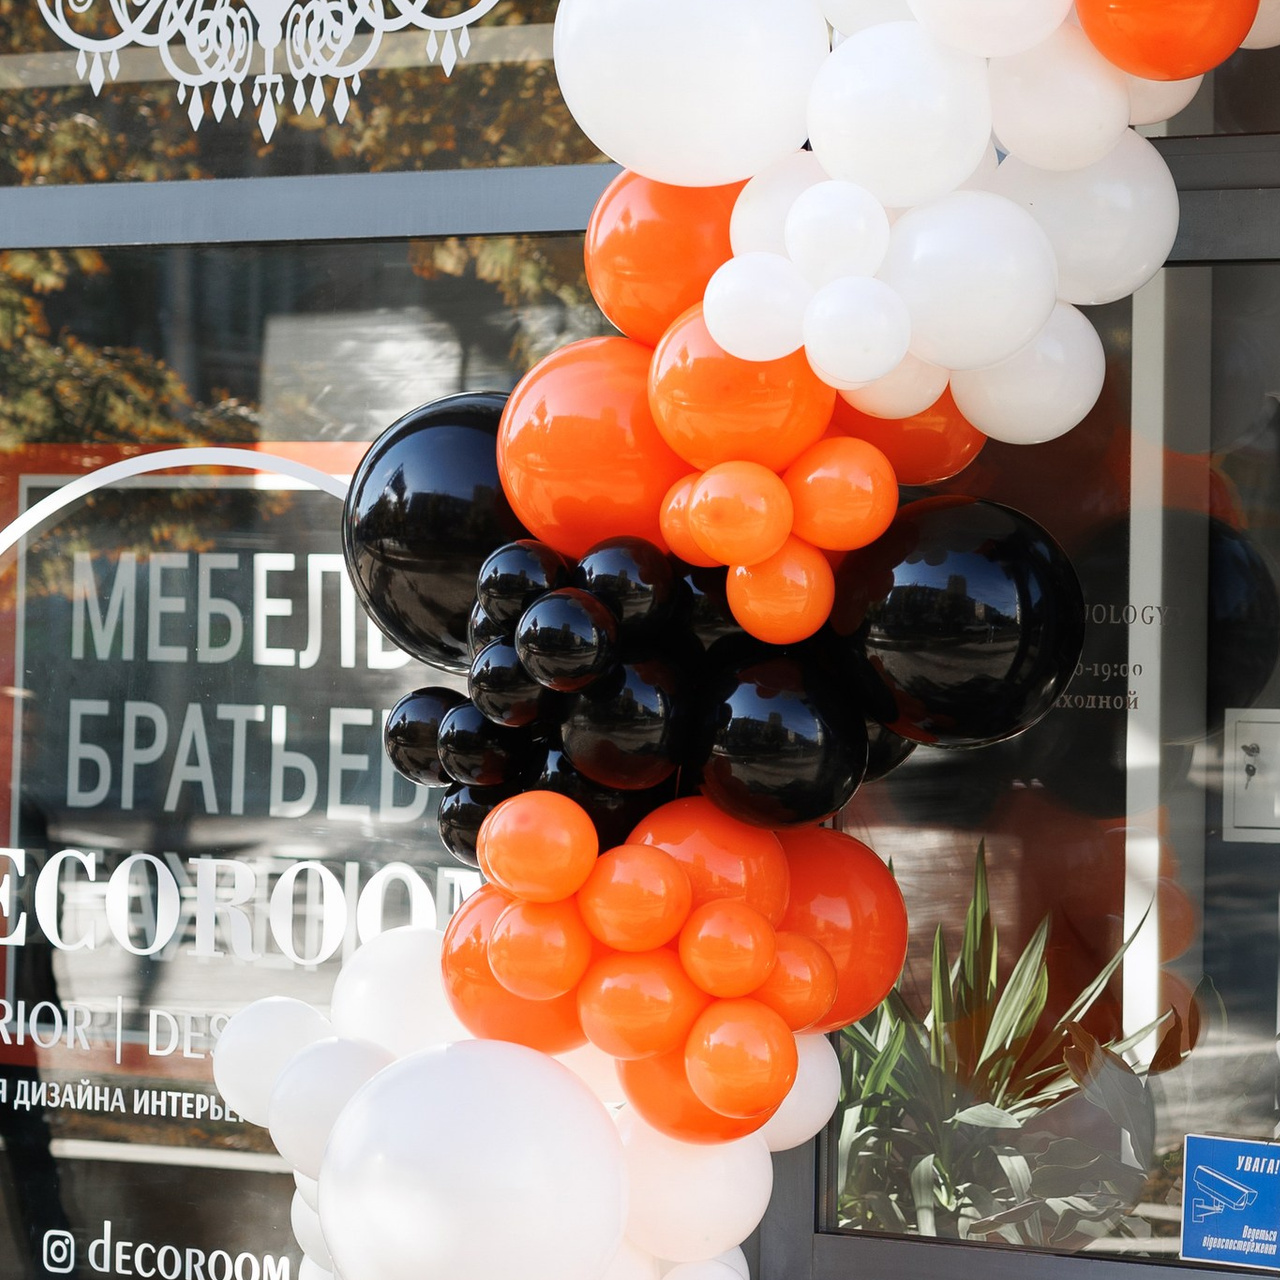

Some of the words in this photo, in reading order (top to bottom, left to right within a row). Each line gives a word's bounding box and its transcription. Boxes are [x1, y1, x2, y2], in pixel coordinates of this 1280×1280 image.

[13, 1078, 126, 1113] ДИЗАЙНА
[133, 1088, 245, 1123] ИНТЕРЬ
[1236, 1155, 1280, 1175] УВАГА!
